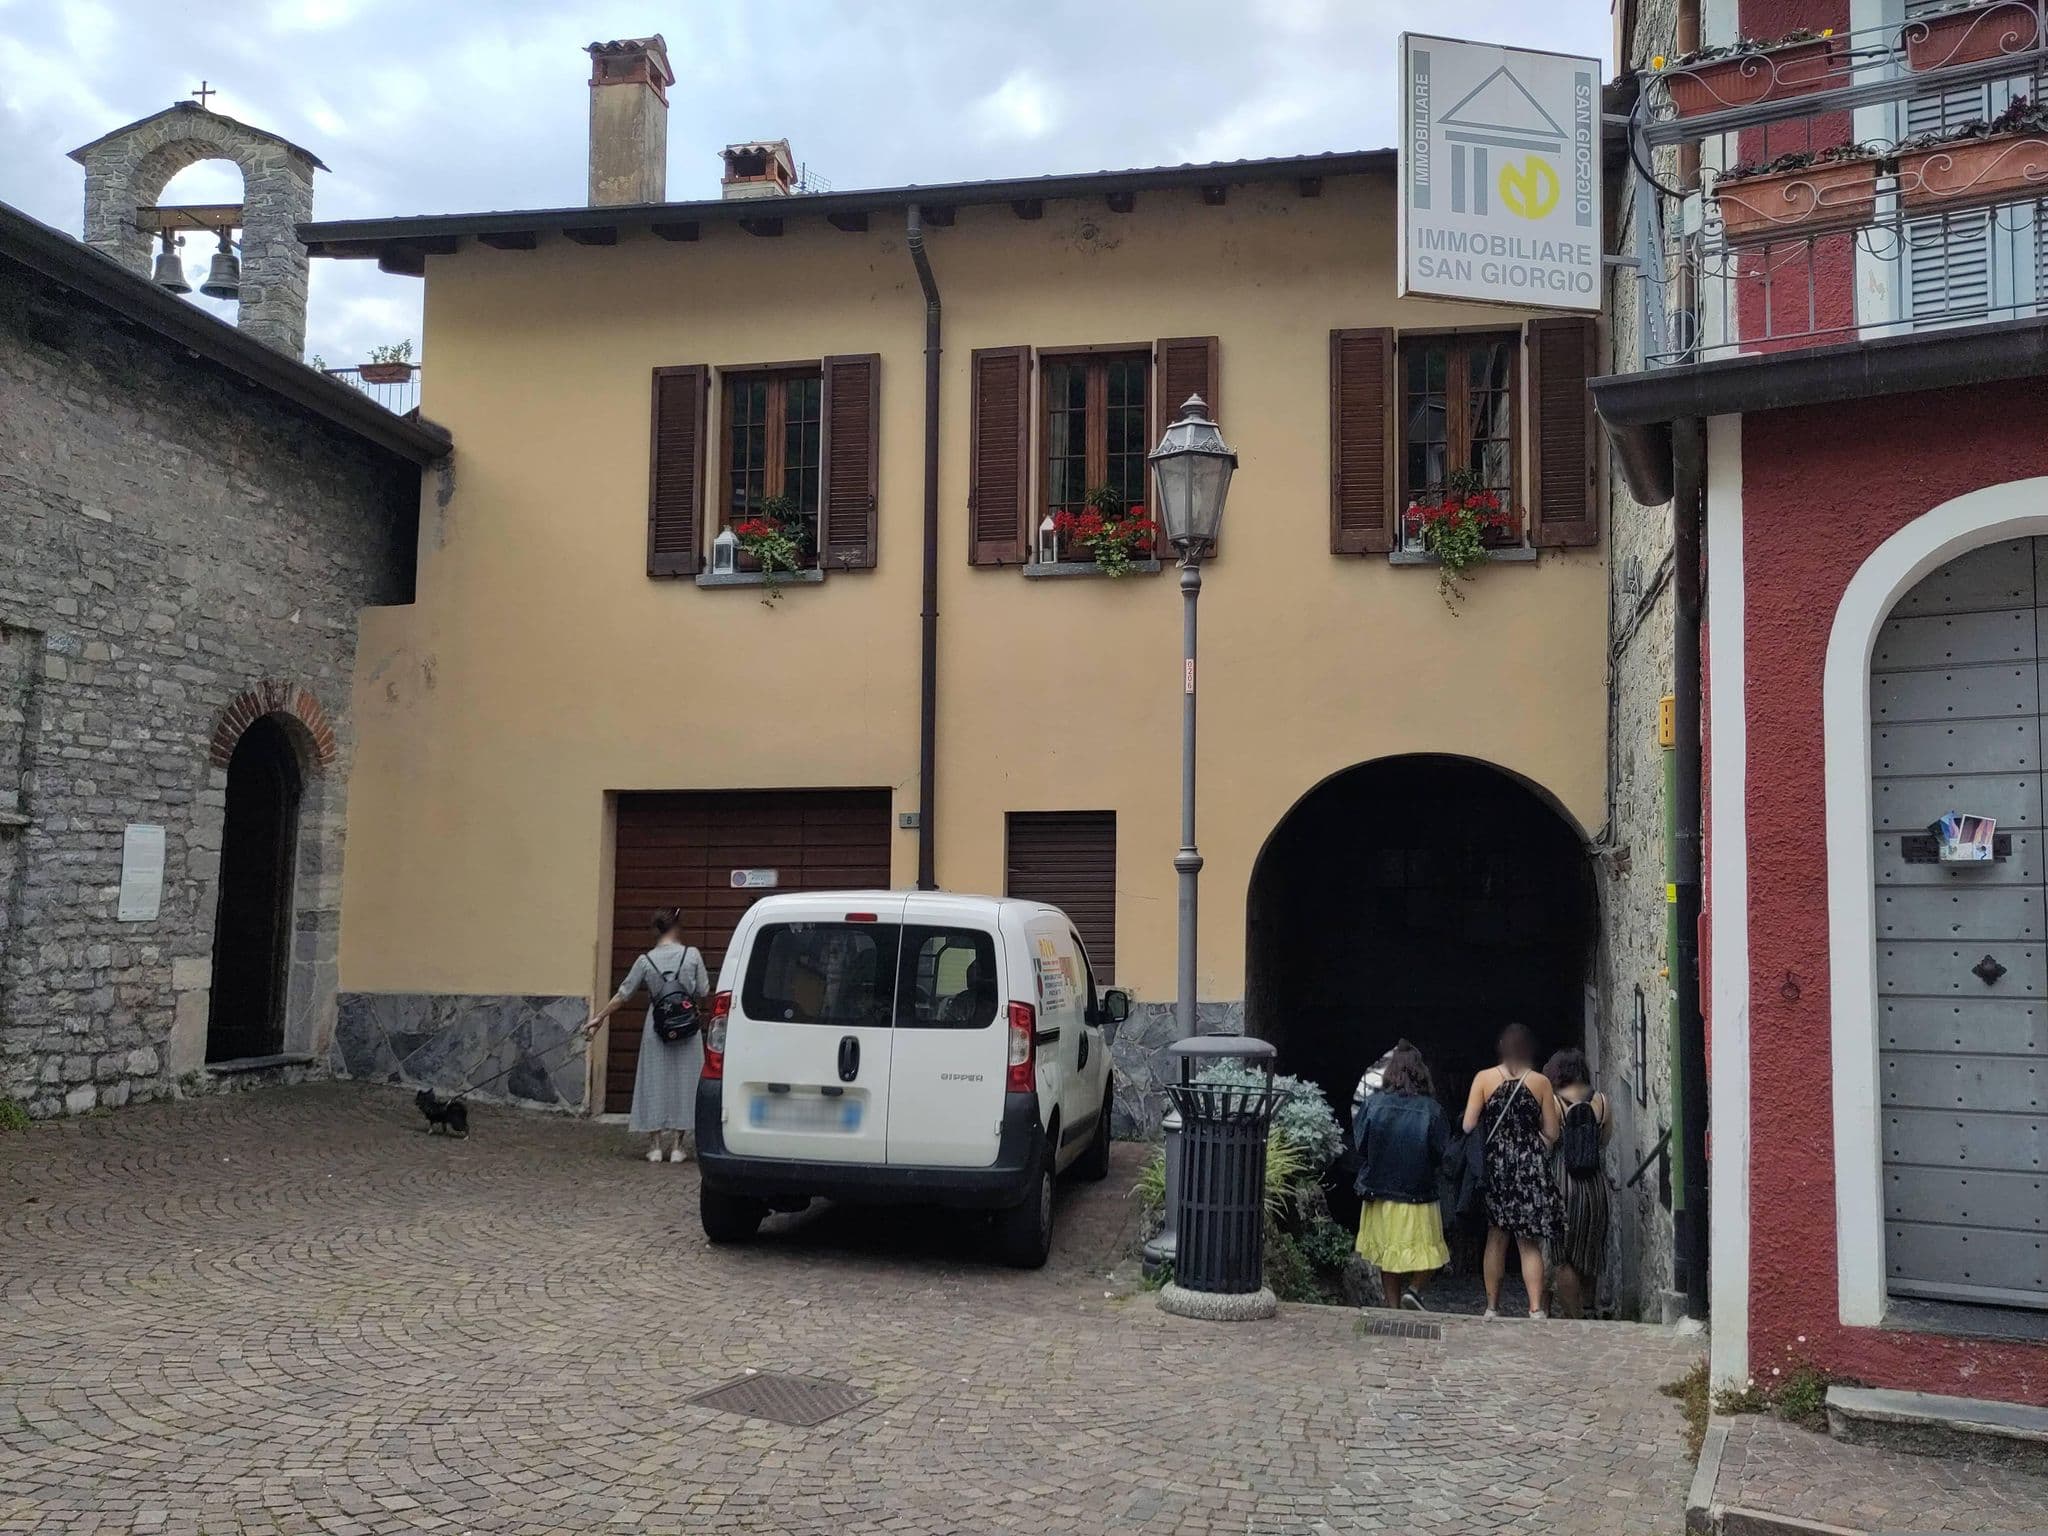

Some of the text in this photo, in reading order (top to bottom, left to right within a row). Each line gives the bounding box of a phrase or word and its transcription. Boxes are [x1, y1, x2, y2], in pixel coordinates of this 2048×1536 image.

[1576, 84, 1590, 124] SAN
[1415, 73, 1430, 186] IMMOBILIARE
[1418, 227, 1592, 266] IMMOBILIARE
[1418, 256, 1594, 294] SAN GIORGIO
